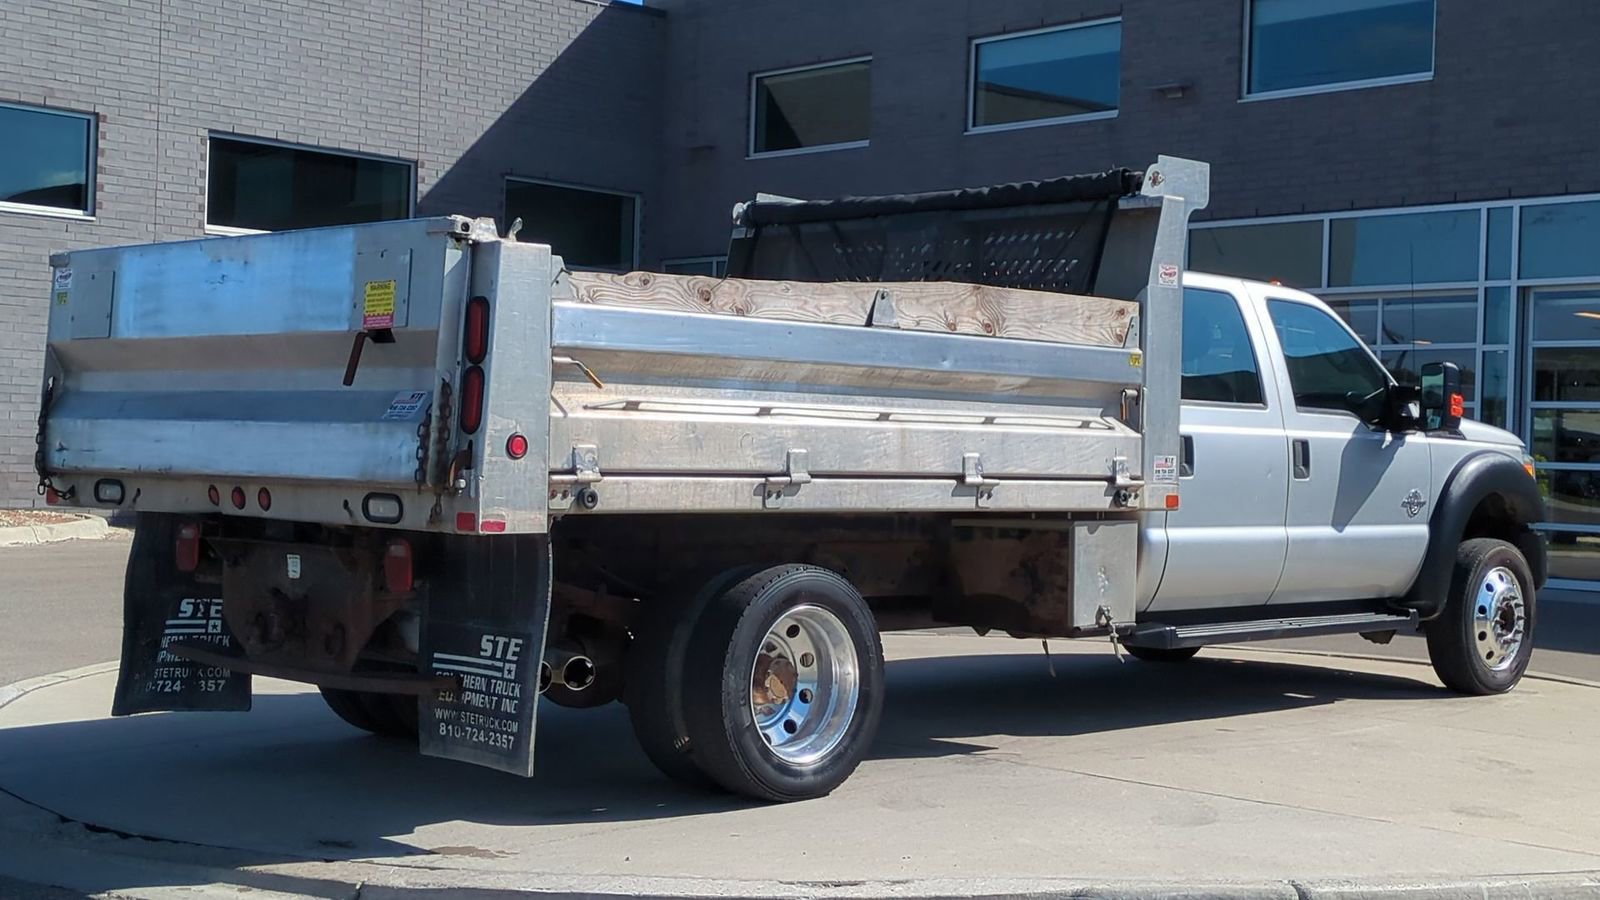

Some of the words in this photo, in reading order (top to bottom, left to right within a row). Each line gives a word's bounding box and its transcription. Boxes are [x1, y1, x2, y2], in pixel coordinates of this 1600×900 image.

[480, 634, 523, 661] STE
[490, 679, 521, 698] TRUCK
[501, 698, 518, 714] INC
[439, 722, 515, 751] 810-724-2357
